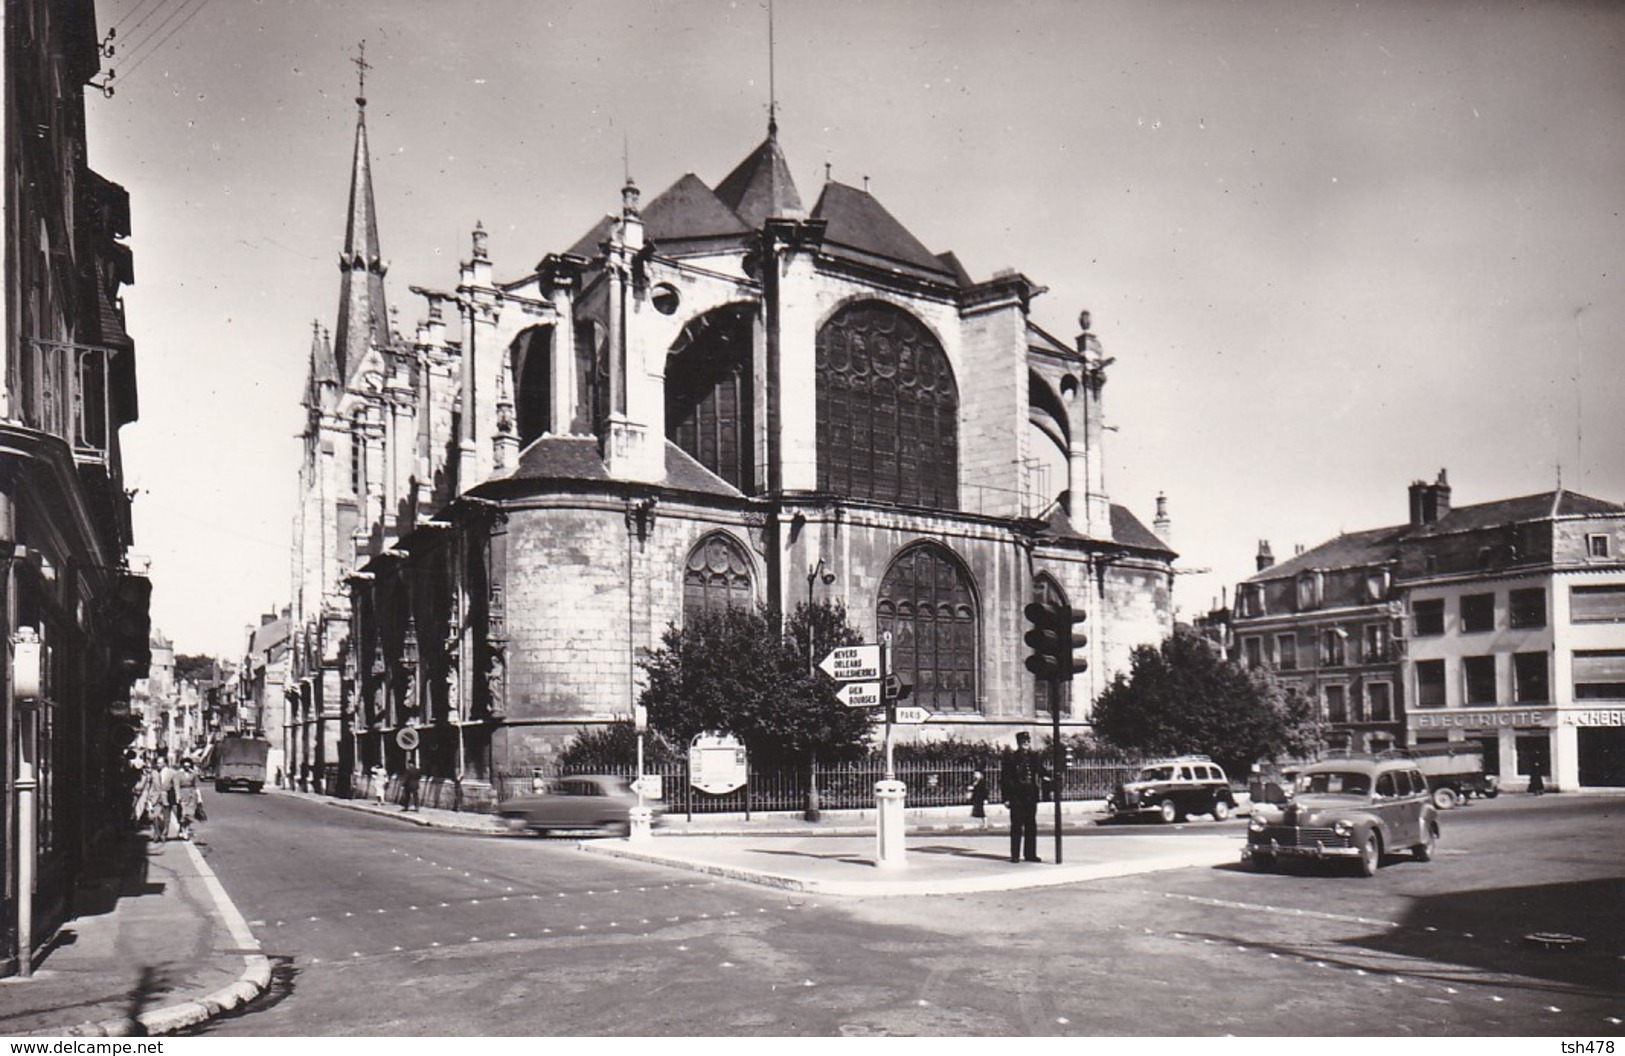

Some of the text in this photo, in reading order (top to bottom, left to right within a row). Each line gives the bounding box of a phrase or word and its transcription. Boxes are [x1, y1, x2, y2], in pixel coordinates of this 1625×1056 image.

[834, 649, 857, 659] NEVERS
[834, 659, 862, 668] ORLEANS
[834, 668, 877, 678] MALESHERBES
[848, 686, 863, 695] GIEN
[848, 695, 877, 704] BOURGES
[900, 710, 922, 720] PARIS
